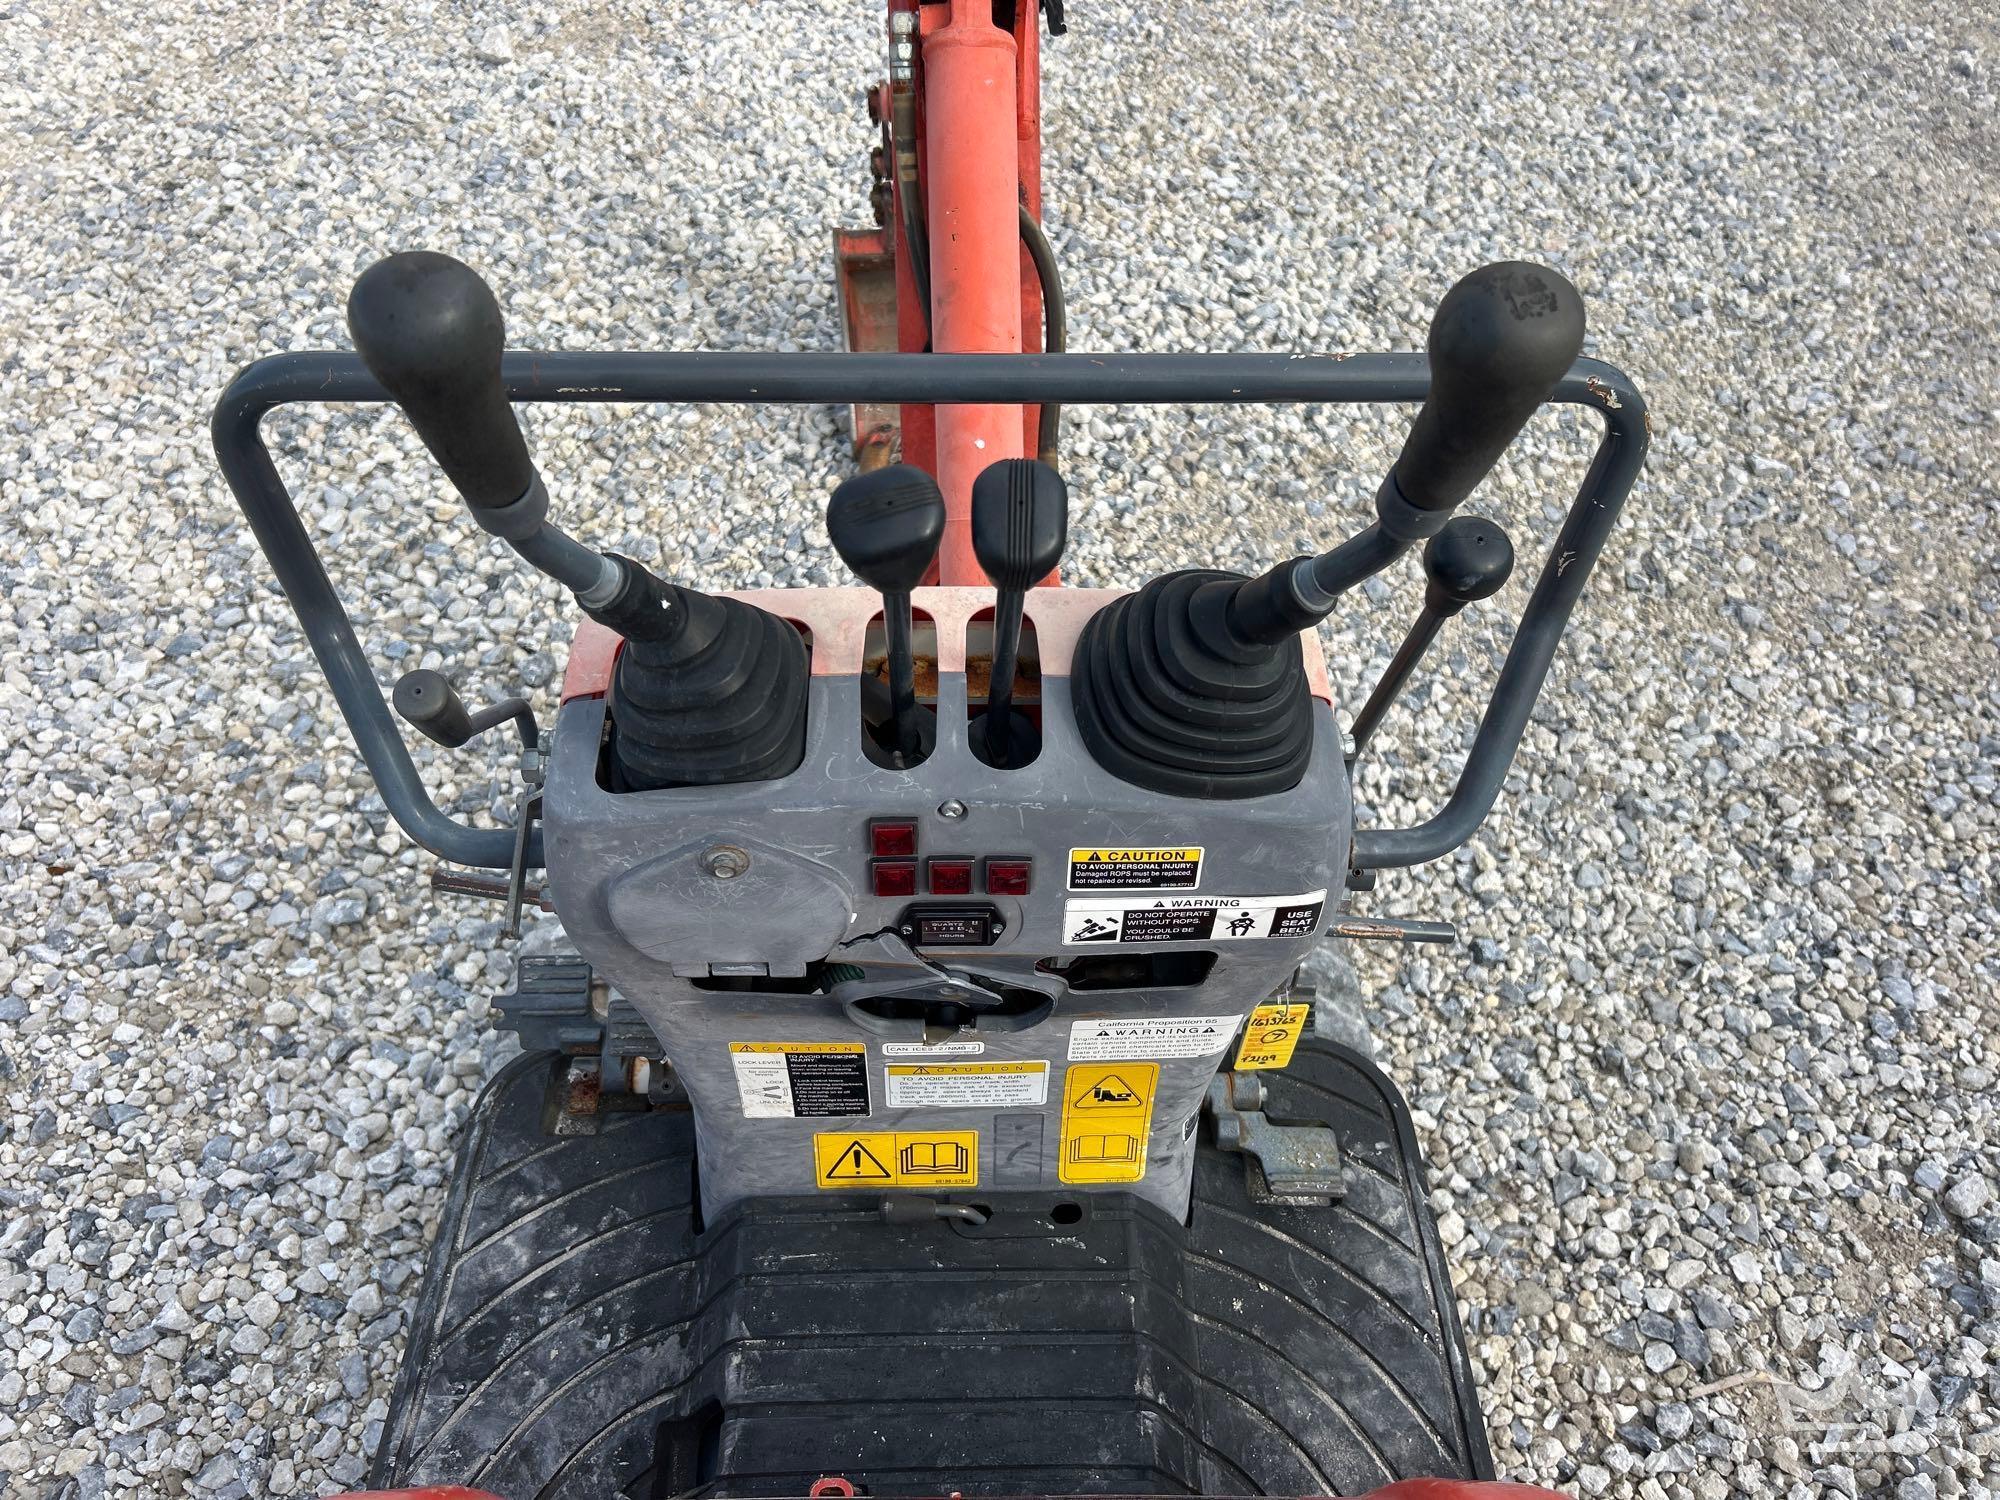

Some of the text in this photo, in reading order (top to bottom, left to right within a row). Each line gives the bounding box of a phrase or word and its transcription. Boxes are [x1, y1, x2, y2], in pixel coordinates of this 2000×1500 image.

[1108, 852, 1185, 861] CAUTION
[1287, 911, 1312, 919] USE
[1281, 918, 1313, 926] SEAT
[1279, 926, 1311, 934] BELT
